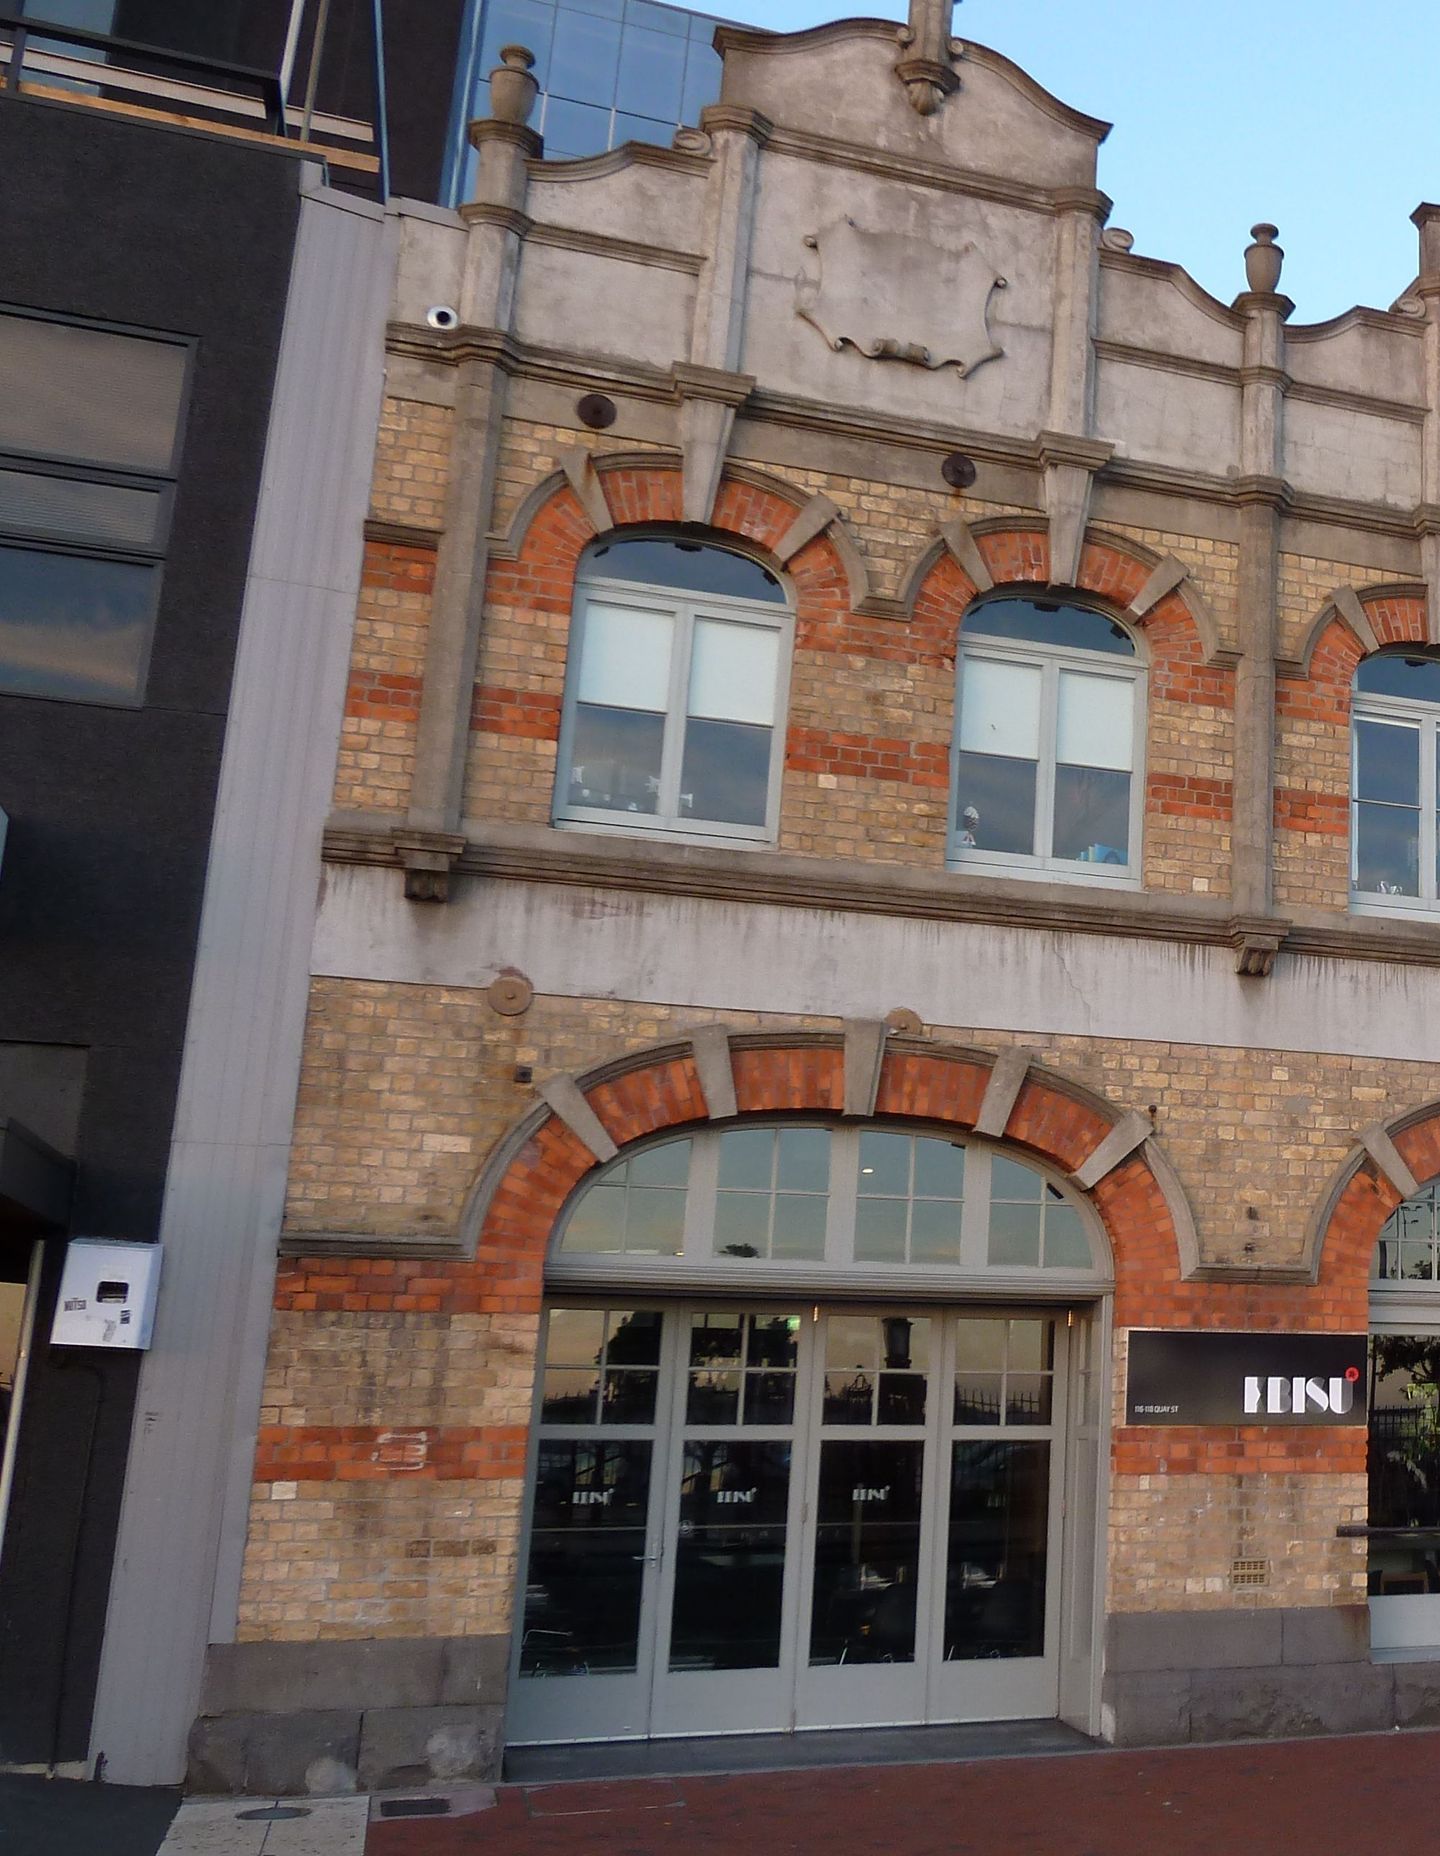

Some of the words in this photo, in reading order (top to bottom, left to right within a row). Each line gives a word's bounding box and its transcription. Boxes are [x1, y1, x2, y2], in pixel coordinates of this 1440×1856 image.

[1243, 1376, 1354, 1414] EBISU
[1154, 1405, 1170, 1413] QUAY
[1170, 1405, 1179, 1413] ST
